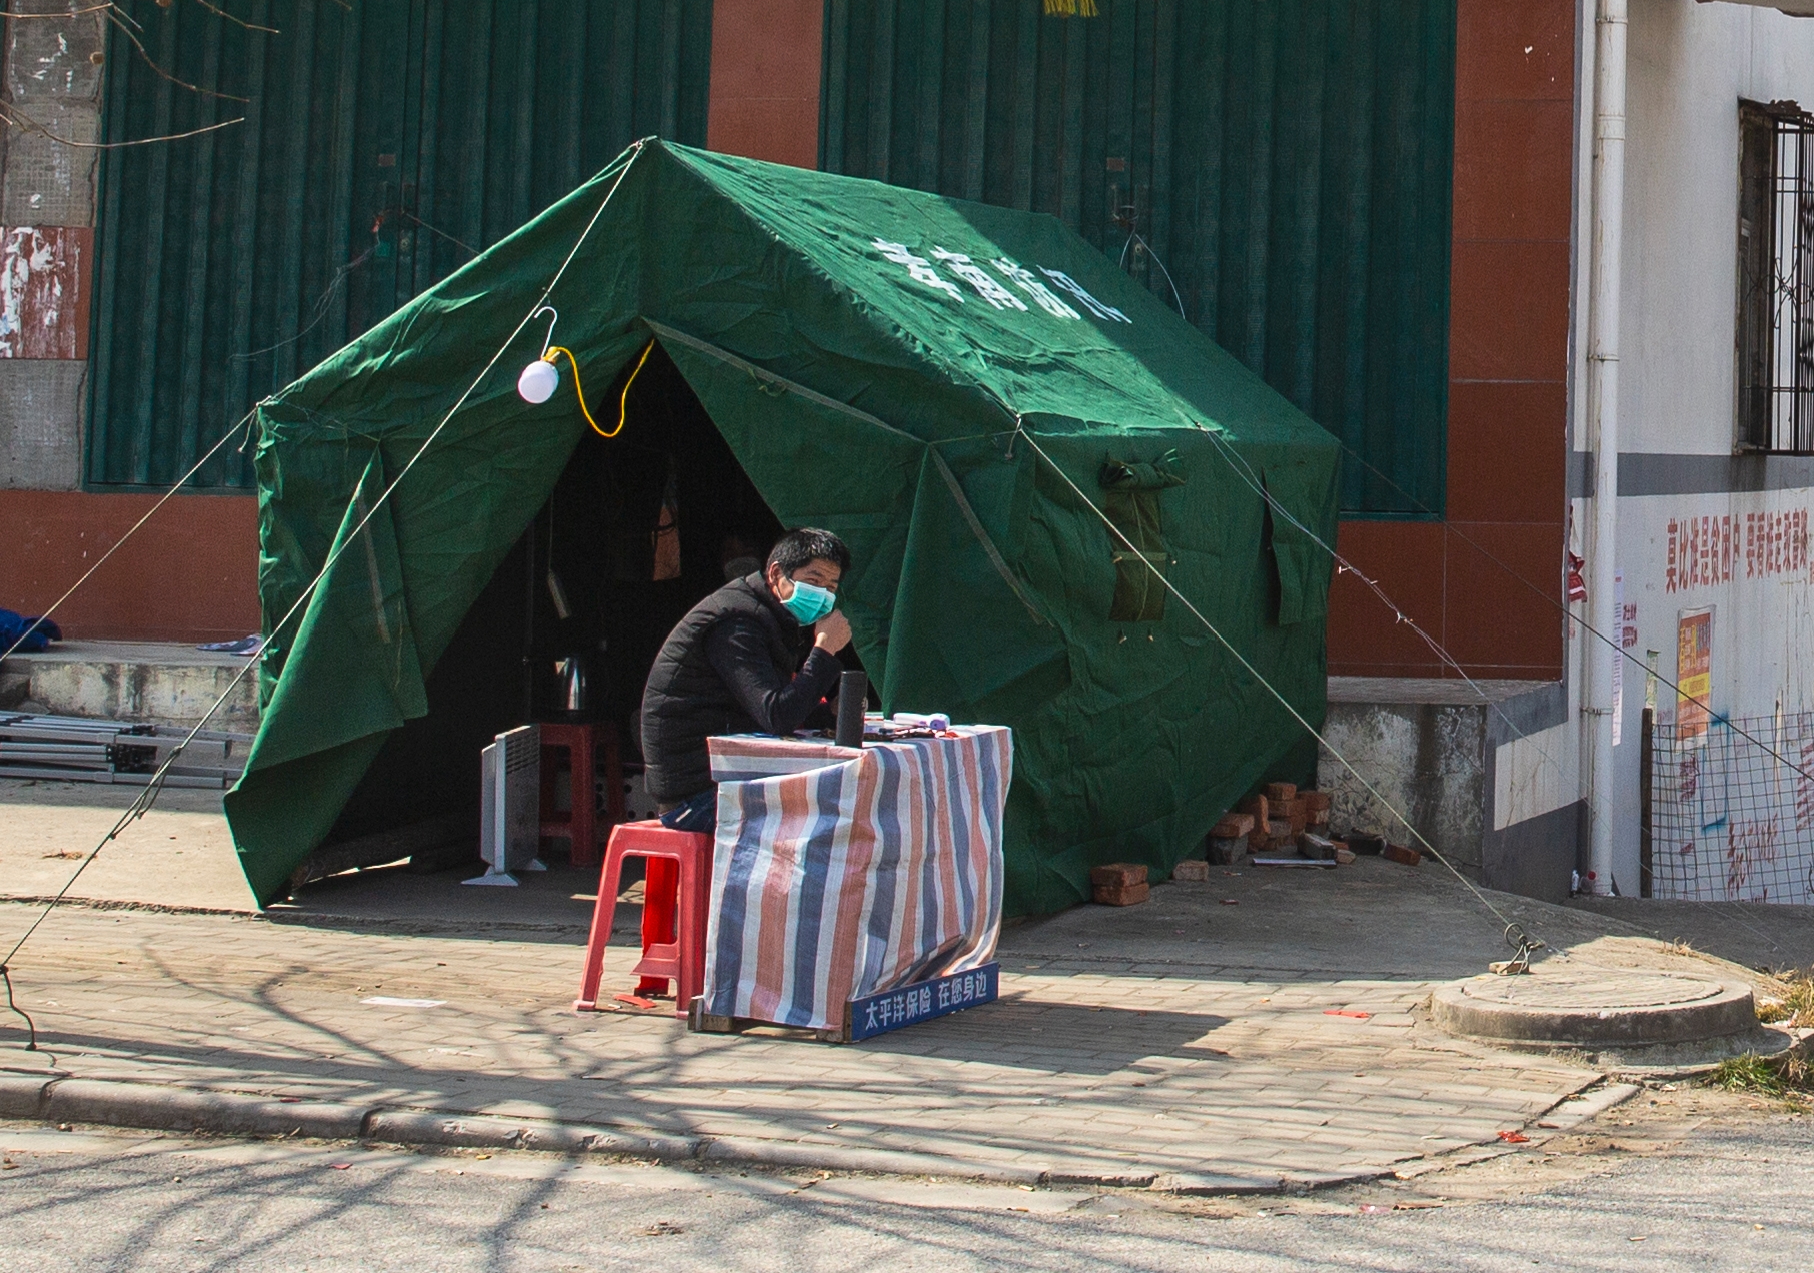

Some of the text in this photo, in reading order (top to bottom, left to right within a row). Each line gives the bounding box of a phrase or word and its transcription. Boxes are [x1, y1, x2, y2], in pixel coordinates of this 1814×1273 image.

[870, 237, 1132, 324] 孝南防汛
[865, 971, 987, 1030] 太平洋保险 在您身边
